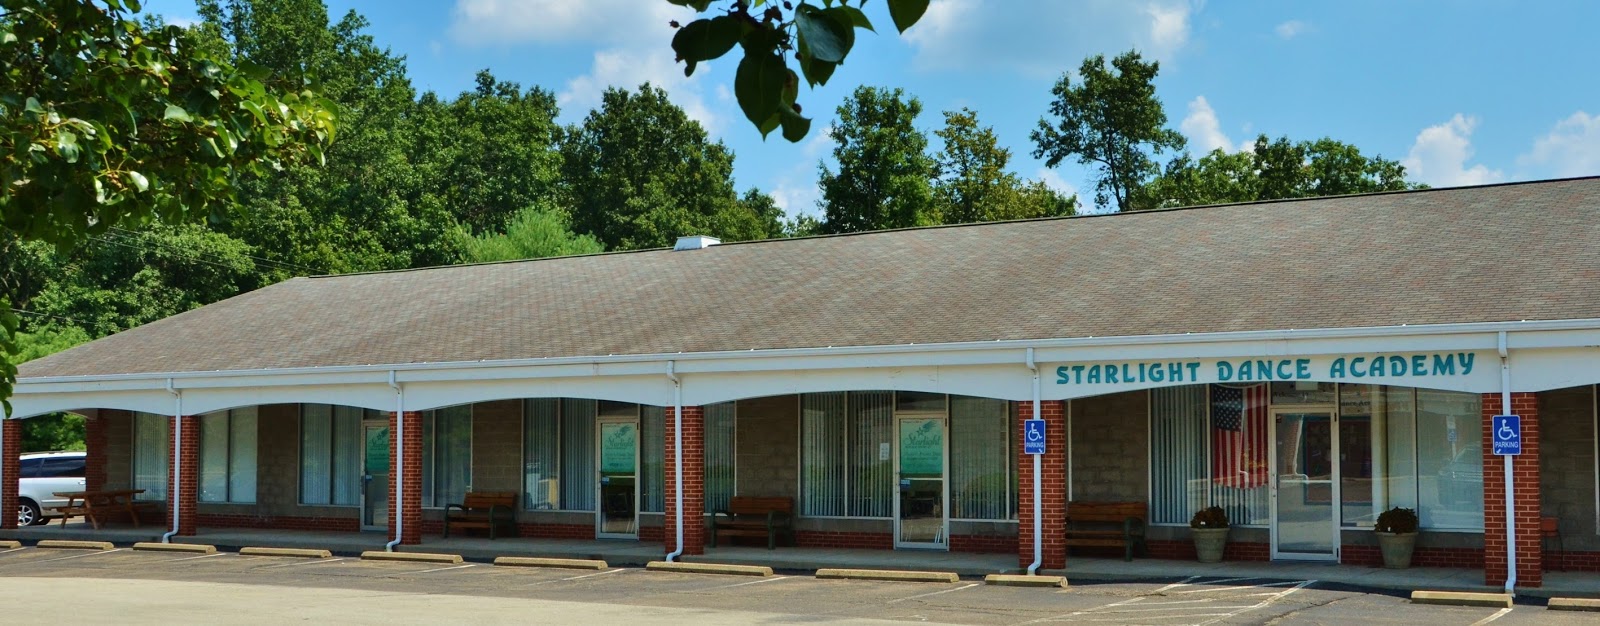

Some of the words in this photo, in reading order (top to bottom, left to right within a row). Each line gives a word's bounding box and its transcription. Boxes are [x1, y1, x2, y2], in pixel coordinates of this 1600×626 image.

[1056, 361, 1200, 385] STARLIGHT
[1217, 359, 1312, 381] DANCE
[1330, 352, 1475, 378] ACADEMY
